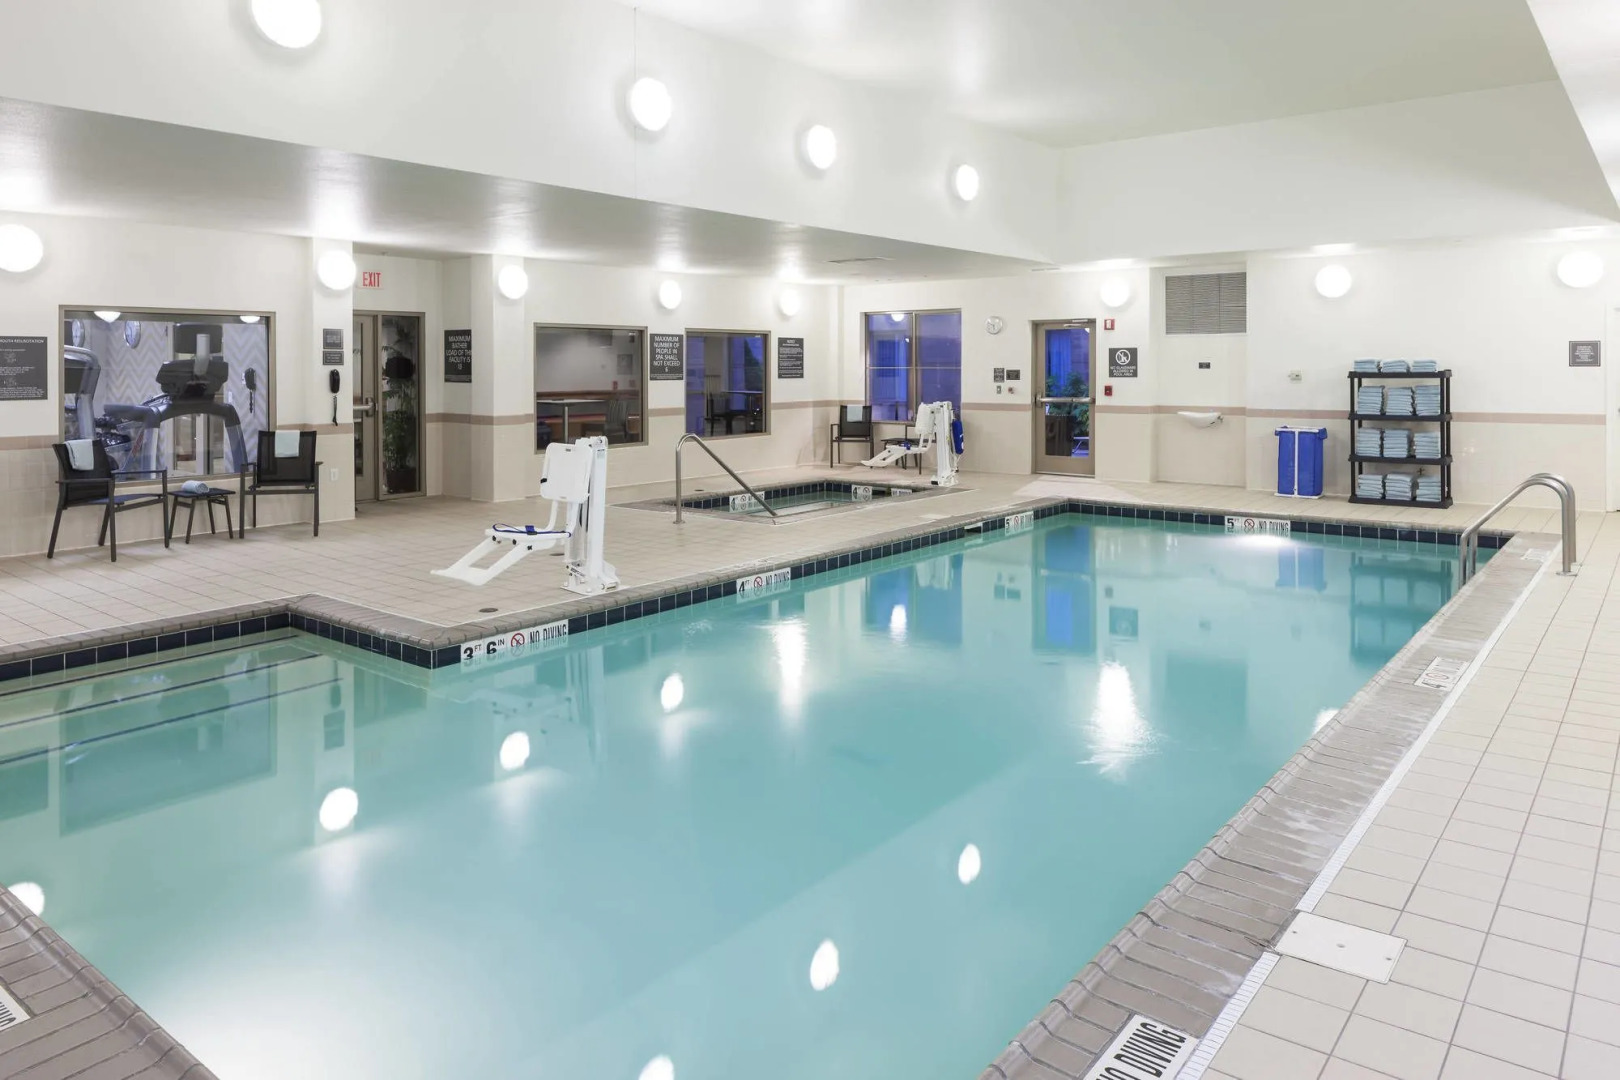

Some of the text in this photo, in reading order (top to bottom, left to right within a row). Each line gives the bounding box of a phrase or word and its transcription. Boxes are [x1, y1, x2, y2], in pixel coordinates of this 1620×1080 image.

[362, 271, 381, 287] EXIT
[529, 630, 541, 644] NO
[543, 623, 567, 641] DIVING
[1113, 1022, 1187, 1078] DIVING
